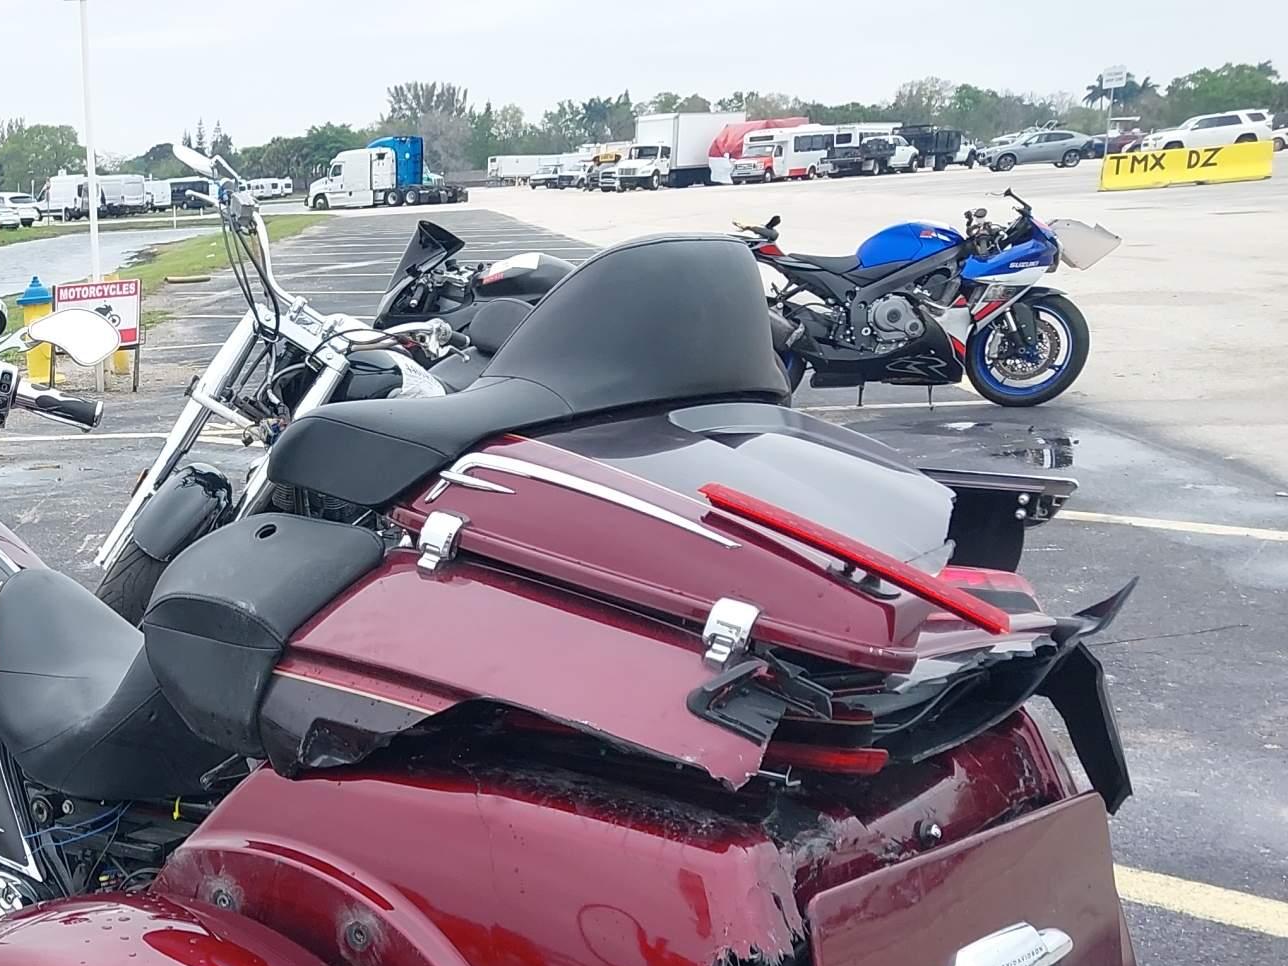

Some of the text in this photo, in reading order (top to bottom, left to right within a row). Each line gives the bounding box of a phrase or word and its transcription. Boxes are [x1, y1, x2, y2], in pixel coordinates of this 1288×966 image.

[1109, 146, 1224, 175] TMX DZ
[1009, 260, 1040, 269] SUZUKI
[59, 283, 136, 301] MOTORCYCLES
